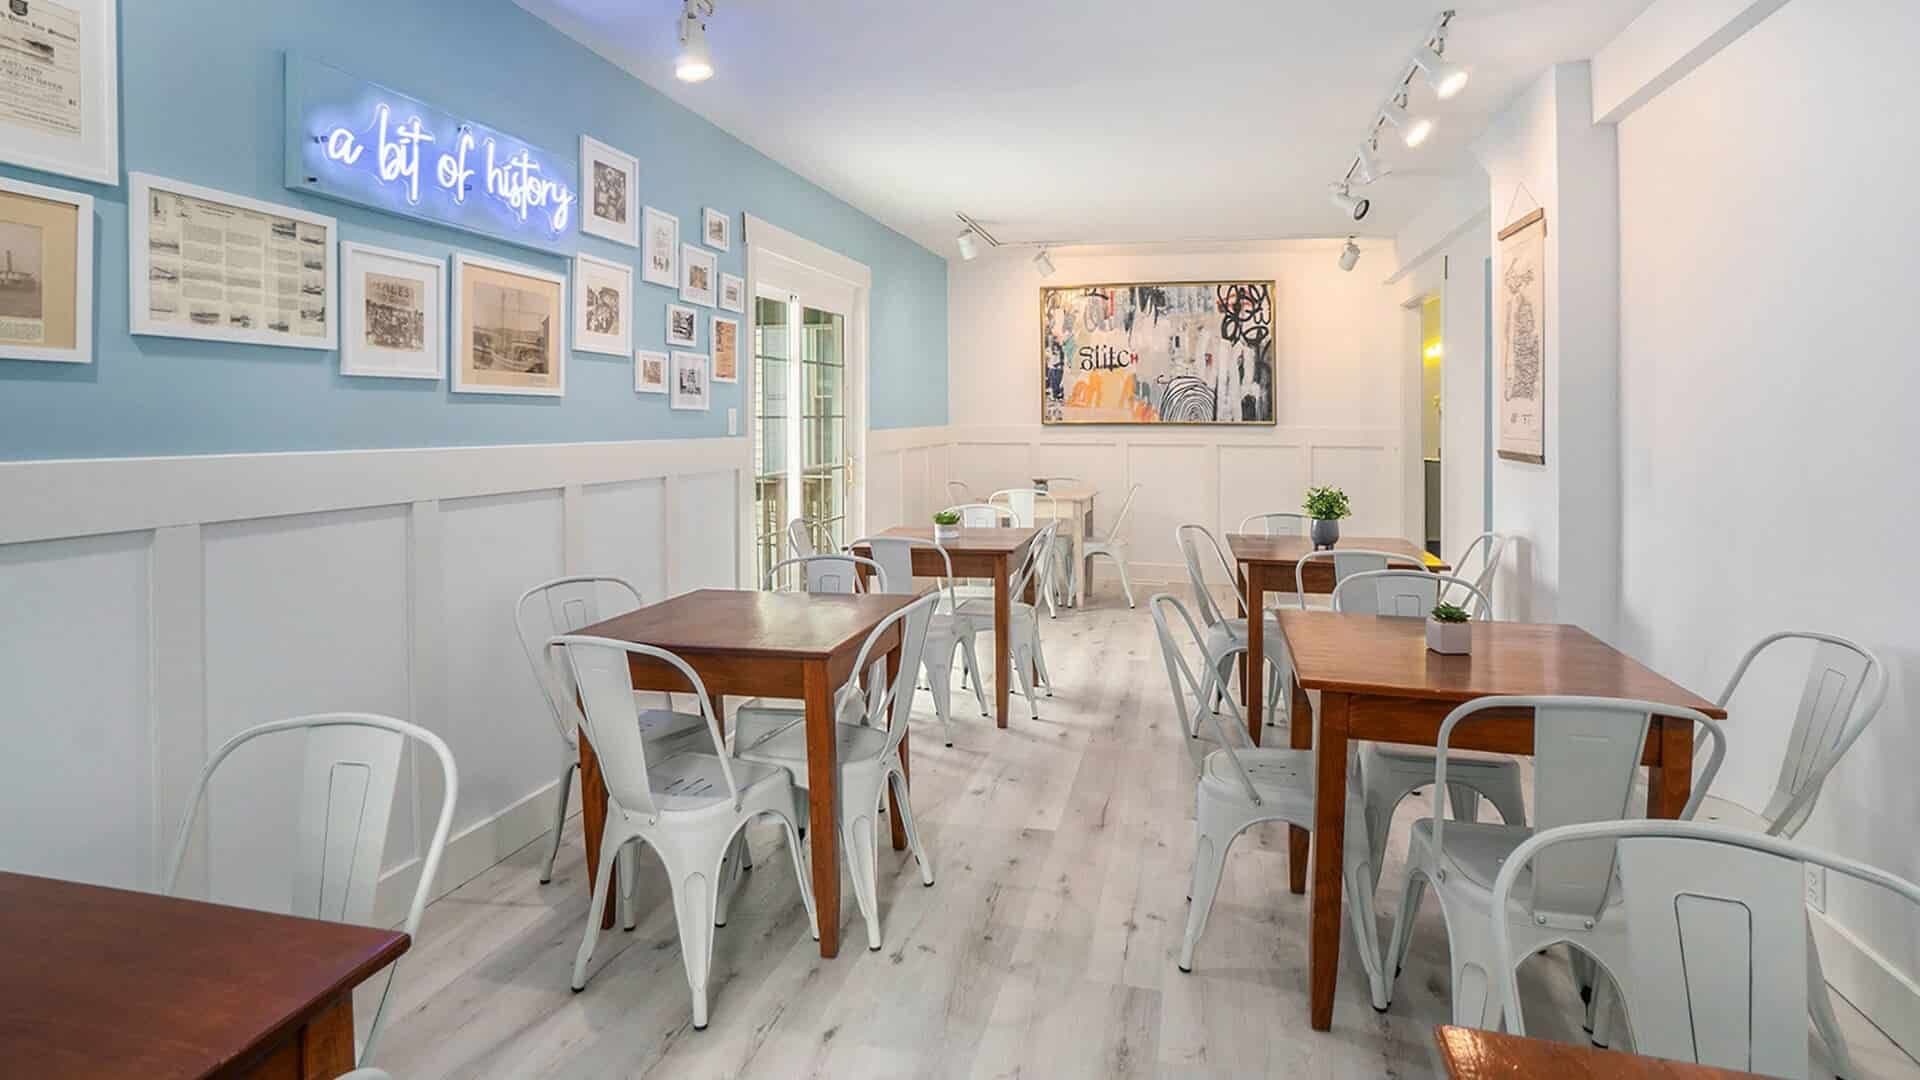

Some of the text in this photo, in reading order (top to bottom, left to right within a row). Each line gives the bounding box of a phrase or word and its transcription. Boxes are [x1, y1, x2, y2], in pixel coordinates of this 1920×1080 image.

[328, 105, 574, 231] a bit of history
